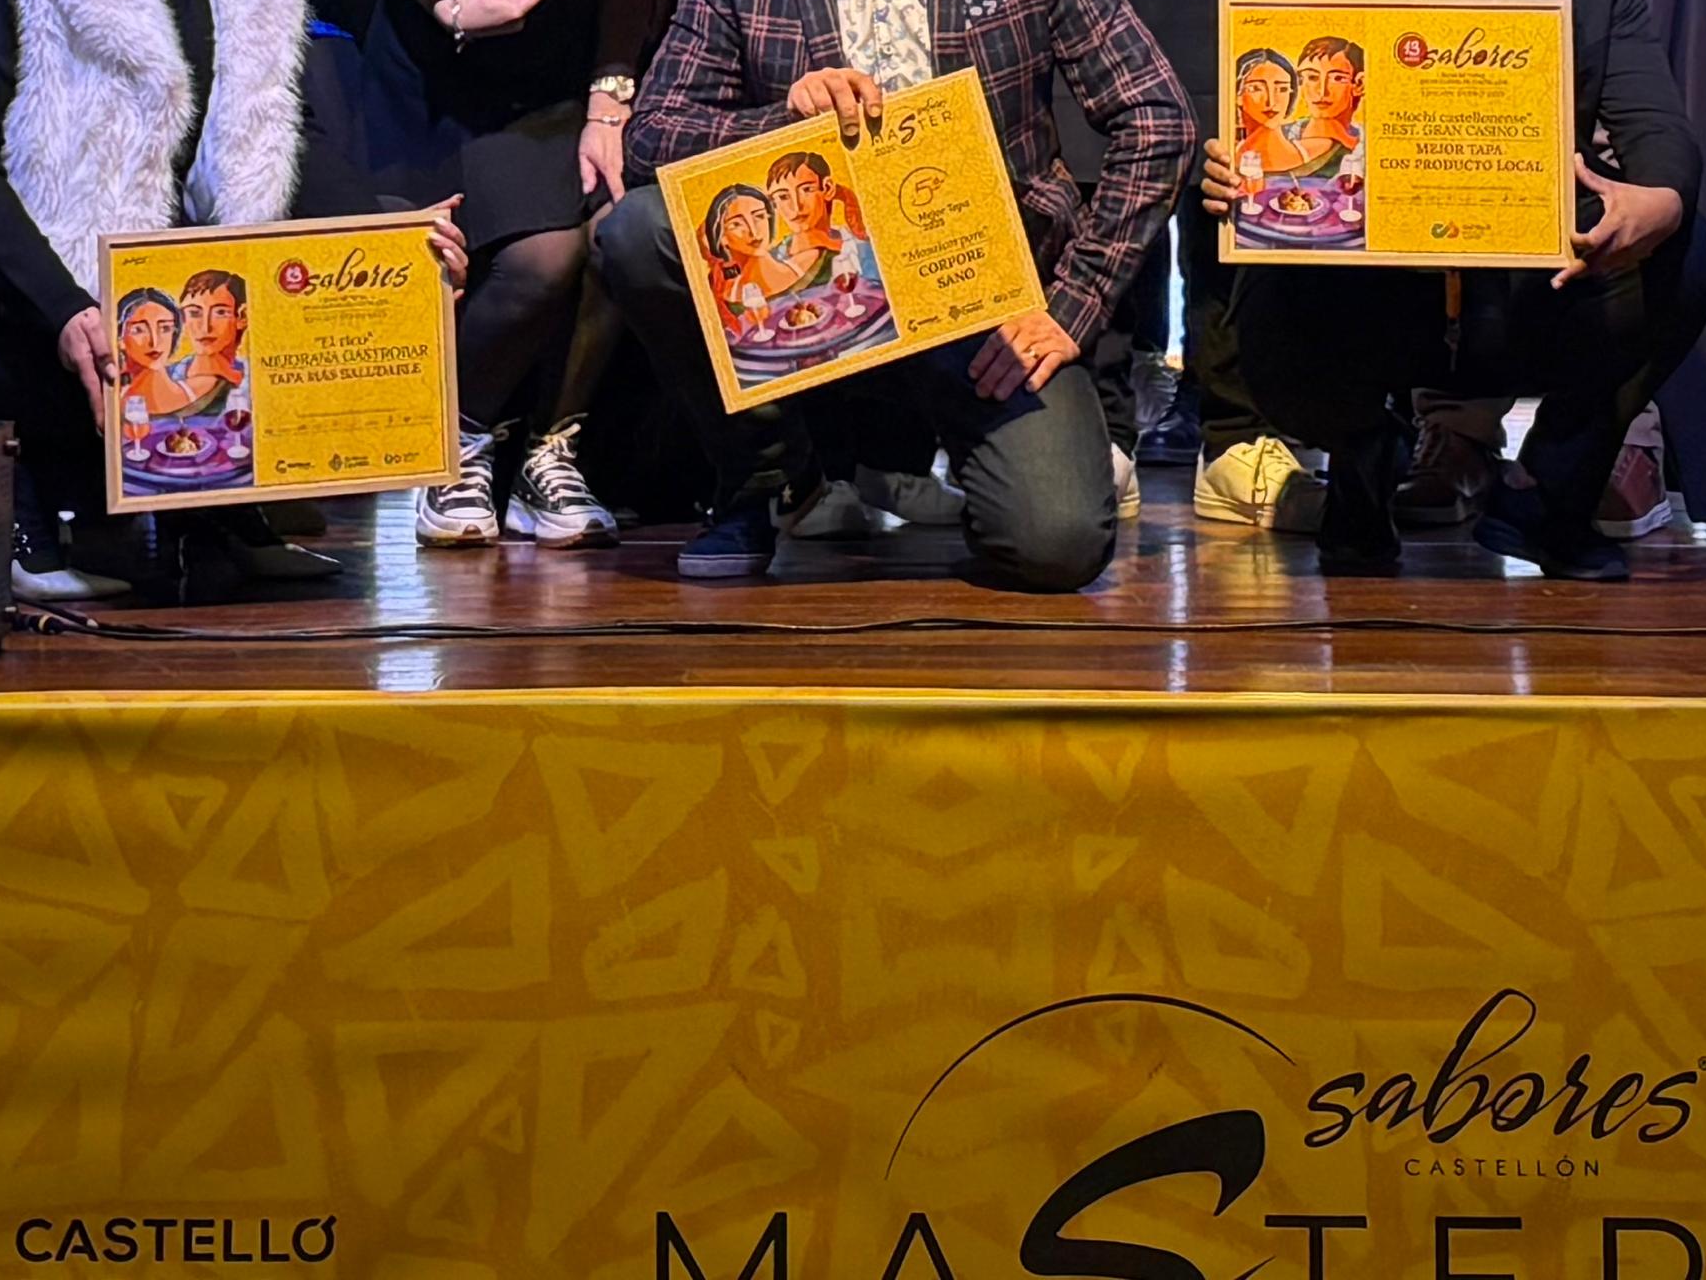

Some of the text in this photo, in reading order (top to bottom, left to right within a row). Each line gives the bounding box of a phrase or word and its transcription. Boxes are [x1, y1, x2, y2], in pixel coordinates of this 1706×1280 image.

[1403, 39, 1420, 56] 13
[1382, 124, 1540, 138] REST. GRAN CASINO CS
[1416, 143, 1503, 156] MEJOR TAPA
[1380, 159, 1543, 172] CON PRODUCTO LOCAL
[918, 247, 986, 278] CORPORE
[936, 267, 976, 289] SANO
[1405, 1154, 1600, 1178] CASTELLÓN
